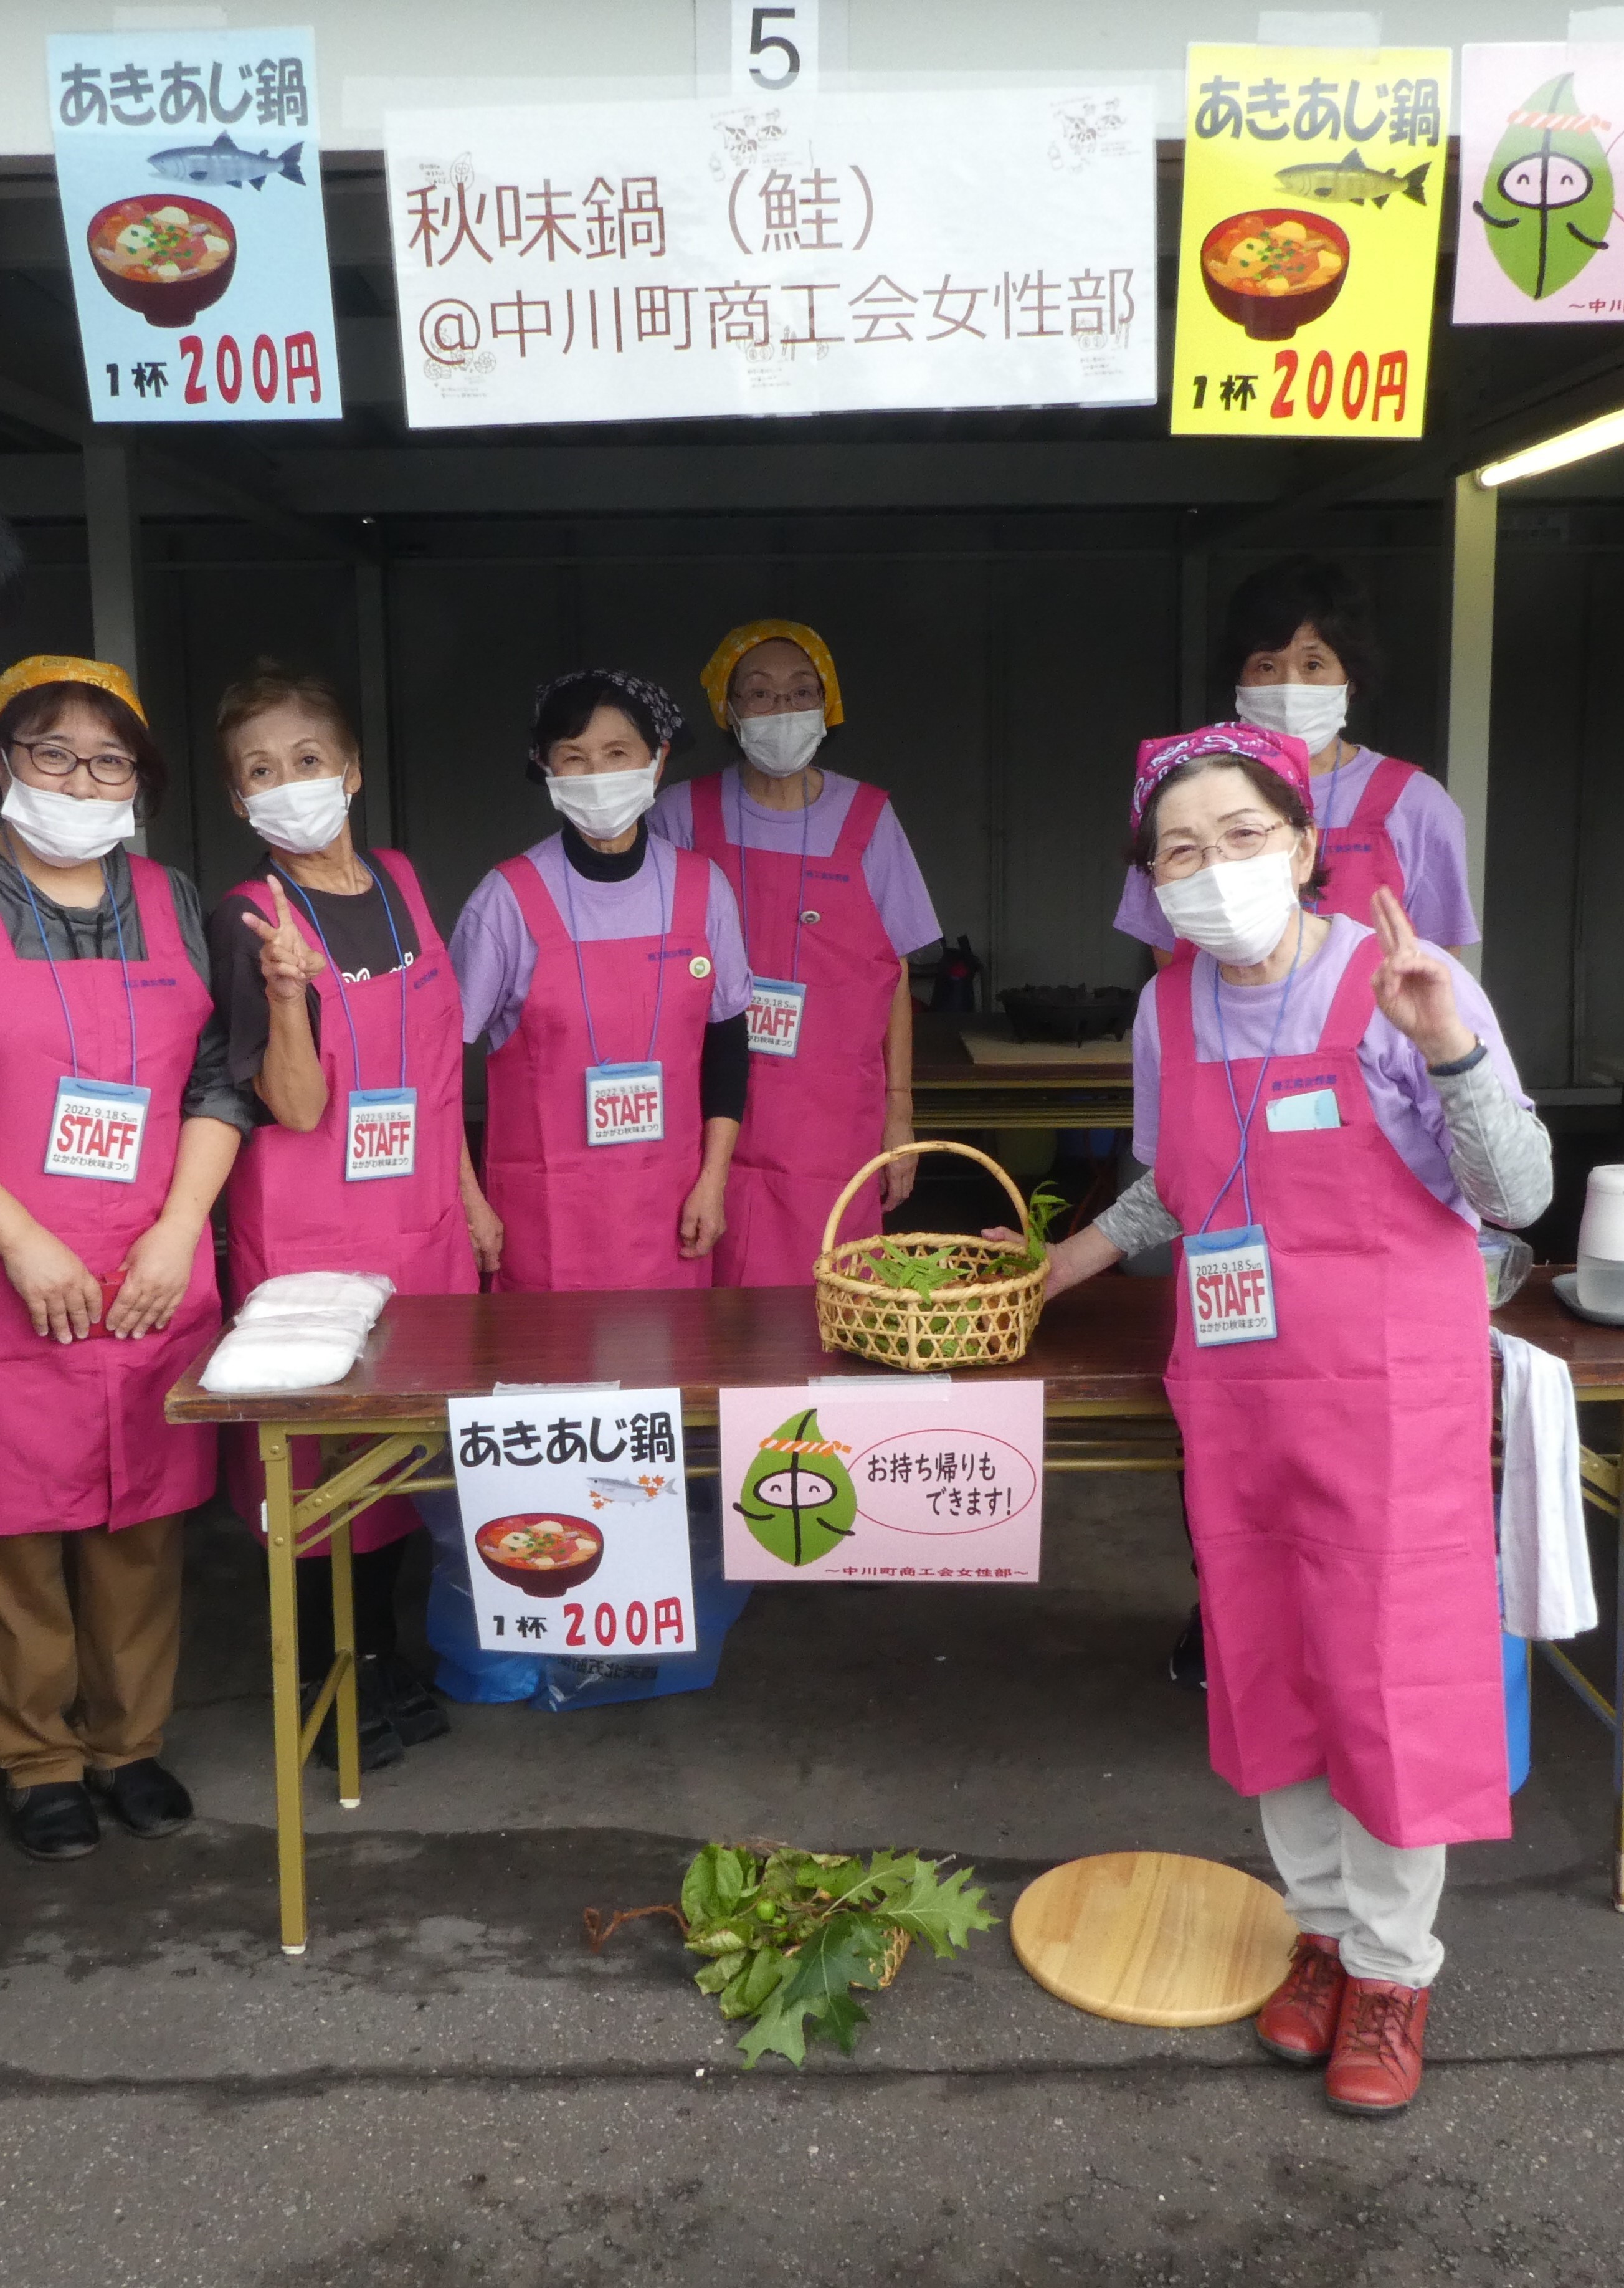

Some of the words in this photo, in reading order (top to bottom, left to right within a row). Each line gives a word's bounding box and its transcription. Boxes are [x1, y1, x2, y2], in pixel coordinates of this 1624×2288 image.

[749, 7, 800, 90] 5
[60, 57, 309, 126] あきあじ鍋
[1195, 75, 1441, 147] あきあじ鍋
[407, 176, 665, 267] 秋味鍋
[419, 268, 1134, 365] @中川町商工会女性部
[179, 331, 321, 404] 200円
[1270, 350, 1408, 422] 200円
[745, 1004, 797, 1038] TAFF
[57, 1113, 138, 1160] STAFF
[594, 1091, 658, 1128] STAFF
[353, 1121, 411, 1158] STAFF
[1196, 1269, 1265, 1320] STAFF
[459, 1411, 677, 1468] あきあじ鍋
[867, 1452, 996, 1484] お持ち帰りも
[926, 1487, 1013, 1517] できます!
[563, 1596, 685, 1647] 200円
